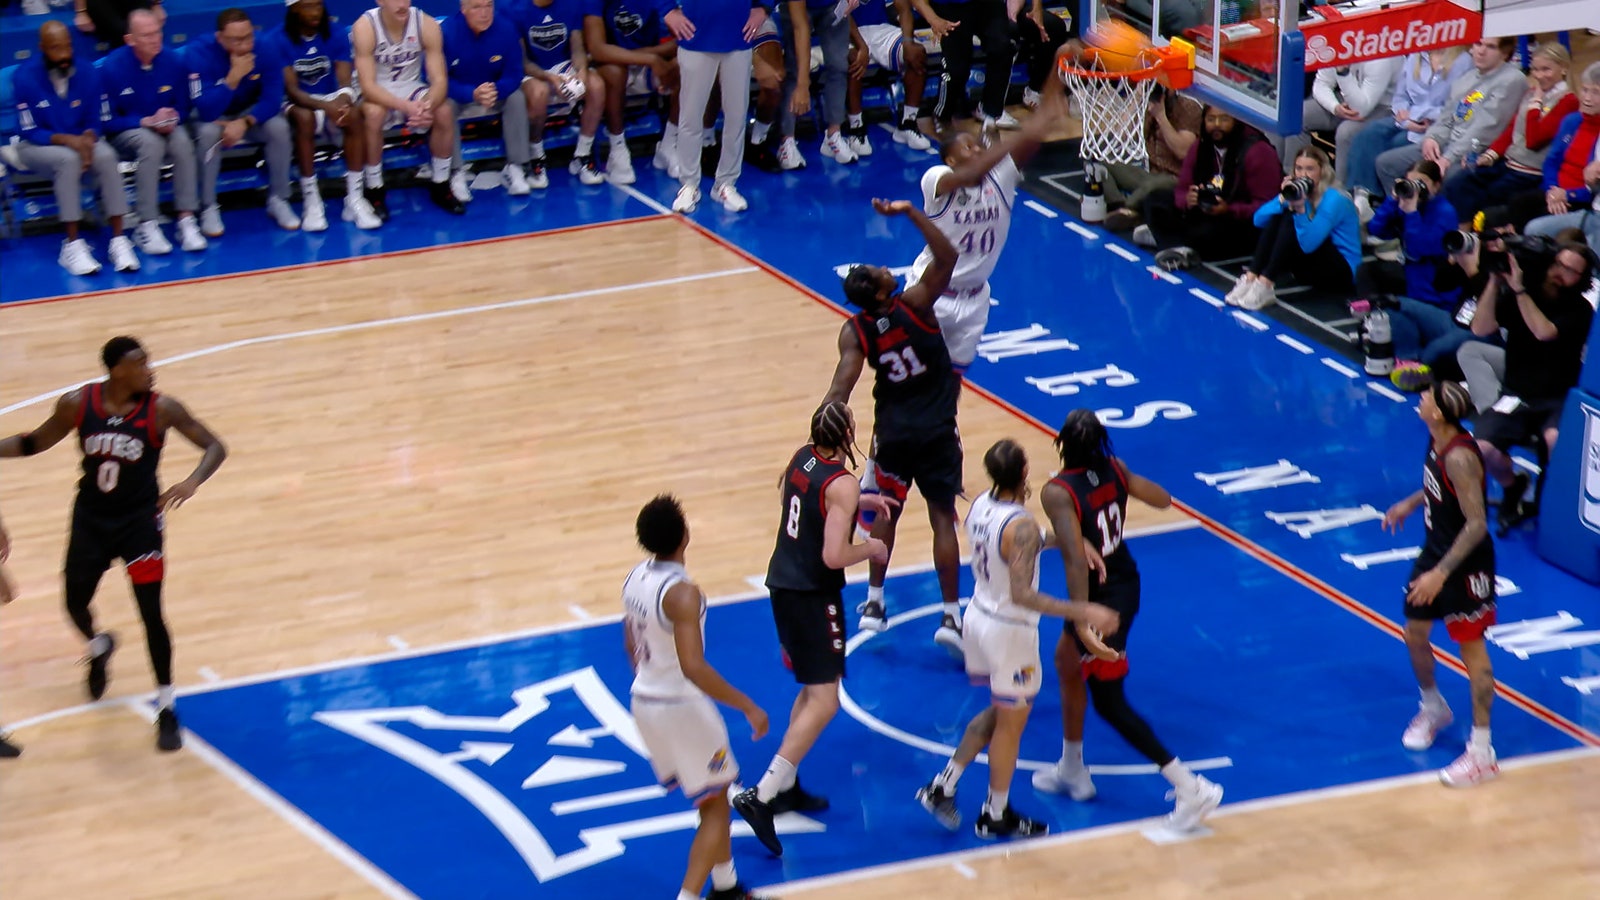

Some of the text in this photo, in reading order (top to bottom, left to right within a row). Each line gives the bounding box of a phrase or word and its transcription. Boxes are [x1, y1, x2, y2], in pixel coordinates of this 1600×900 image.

[391, 66, 405, 81] 7
[959, 228, 995, 254] 40
[879, 345, 927, 383] 31
[84, 433, 144, 461] UTES
[97, 461, 120, 493] 0
[787, 495, 801, 539] 8
[1097, 502, 1122, 557] 13
[827, 604, 843, 650] SLC
